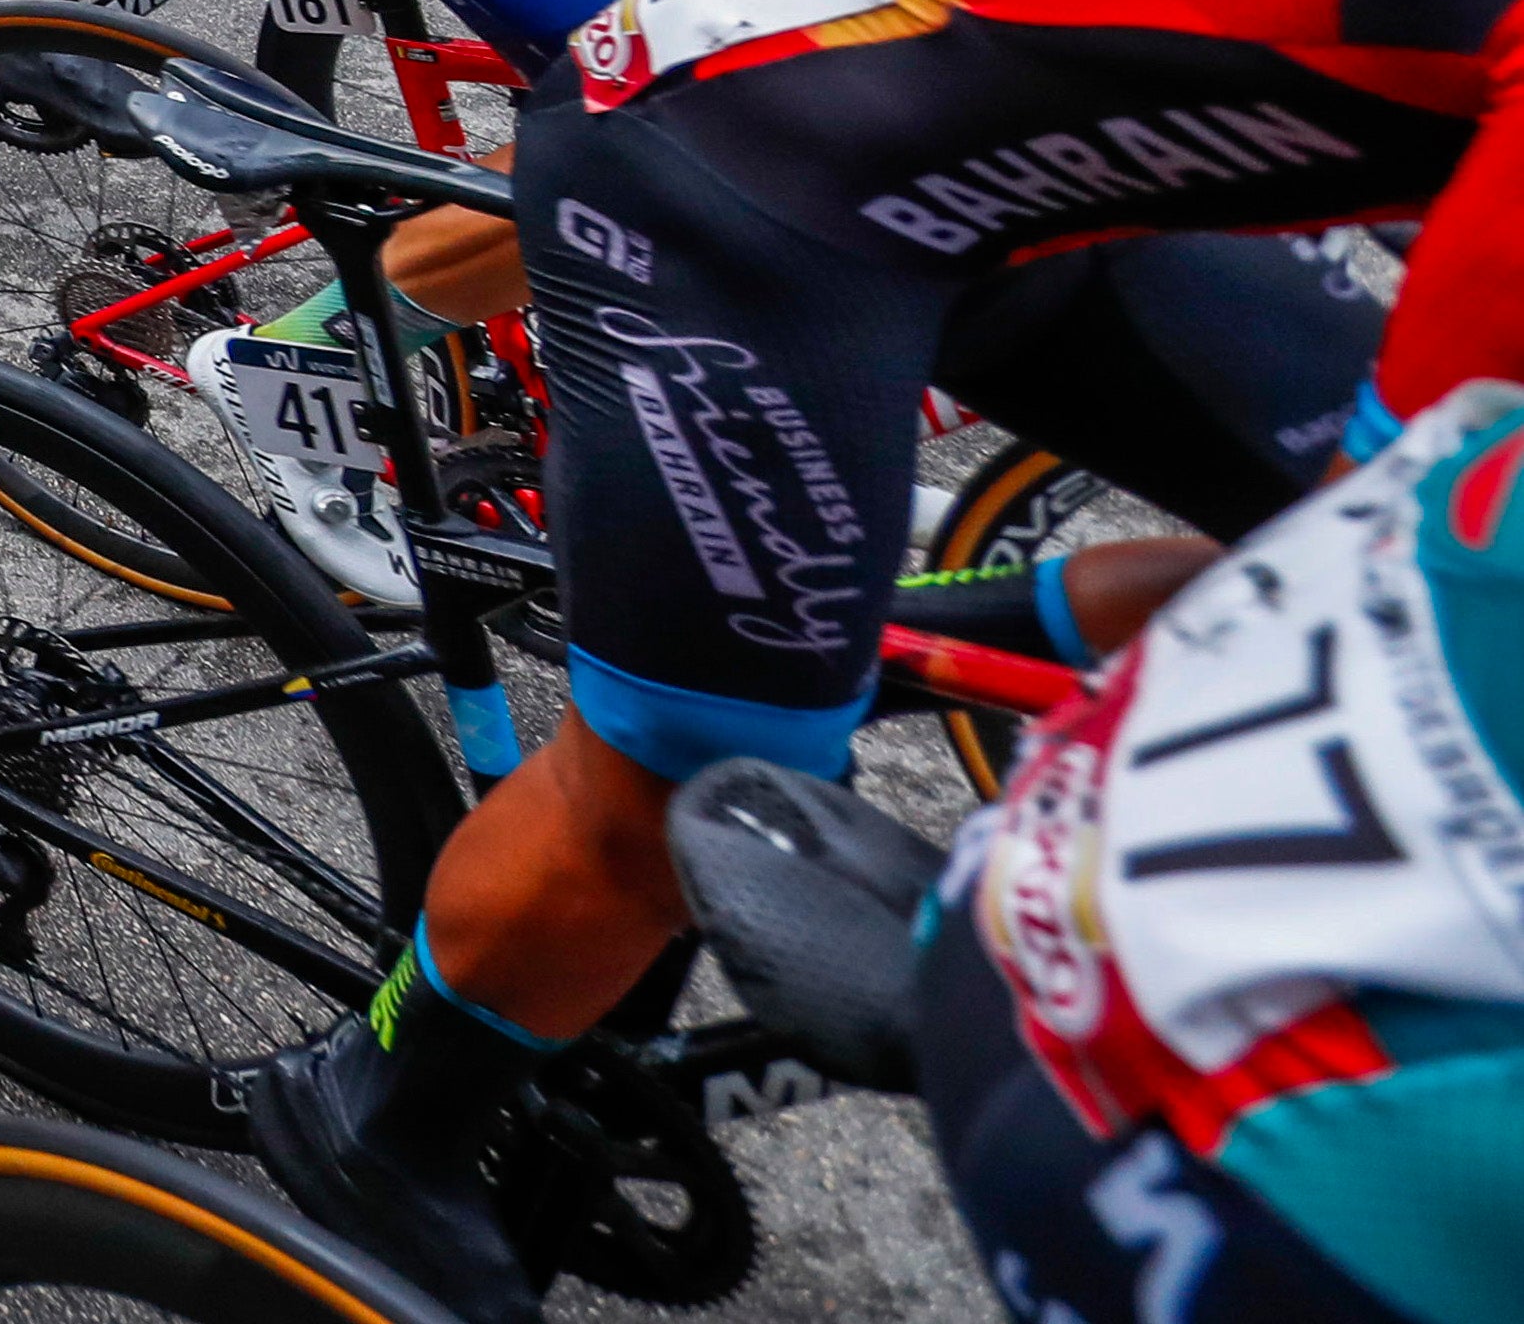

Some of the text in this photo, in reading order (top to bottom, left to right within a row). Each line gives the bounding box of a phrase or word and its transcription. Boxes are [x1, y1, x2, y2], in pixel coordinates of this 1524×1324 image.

[862, 100, 1362, 255] BAHRAIN
[276, 382, 348, 455] 41
[596, 307, 864, 660] friendly
[639, 390, 741, 572] BAHRAIN
[745, 384, 865, 543] BUSINESS
[40, 710, 160, 745] MERIDA
[89, 851, 213, 925] Continental
